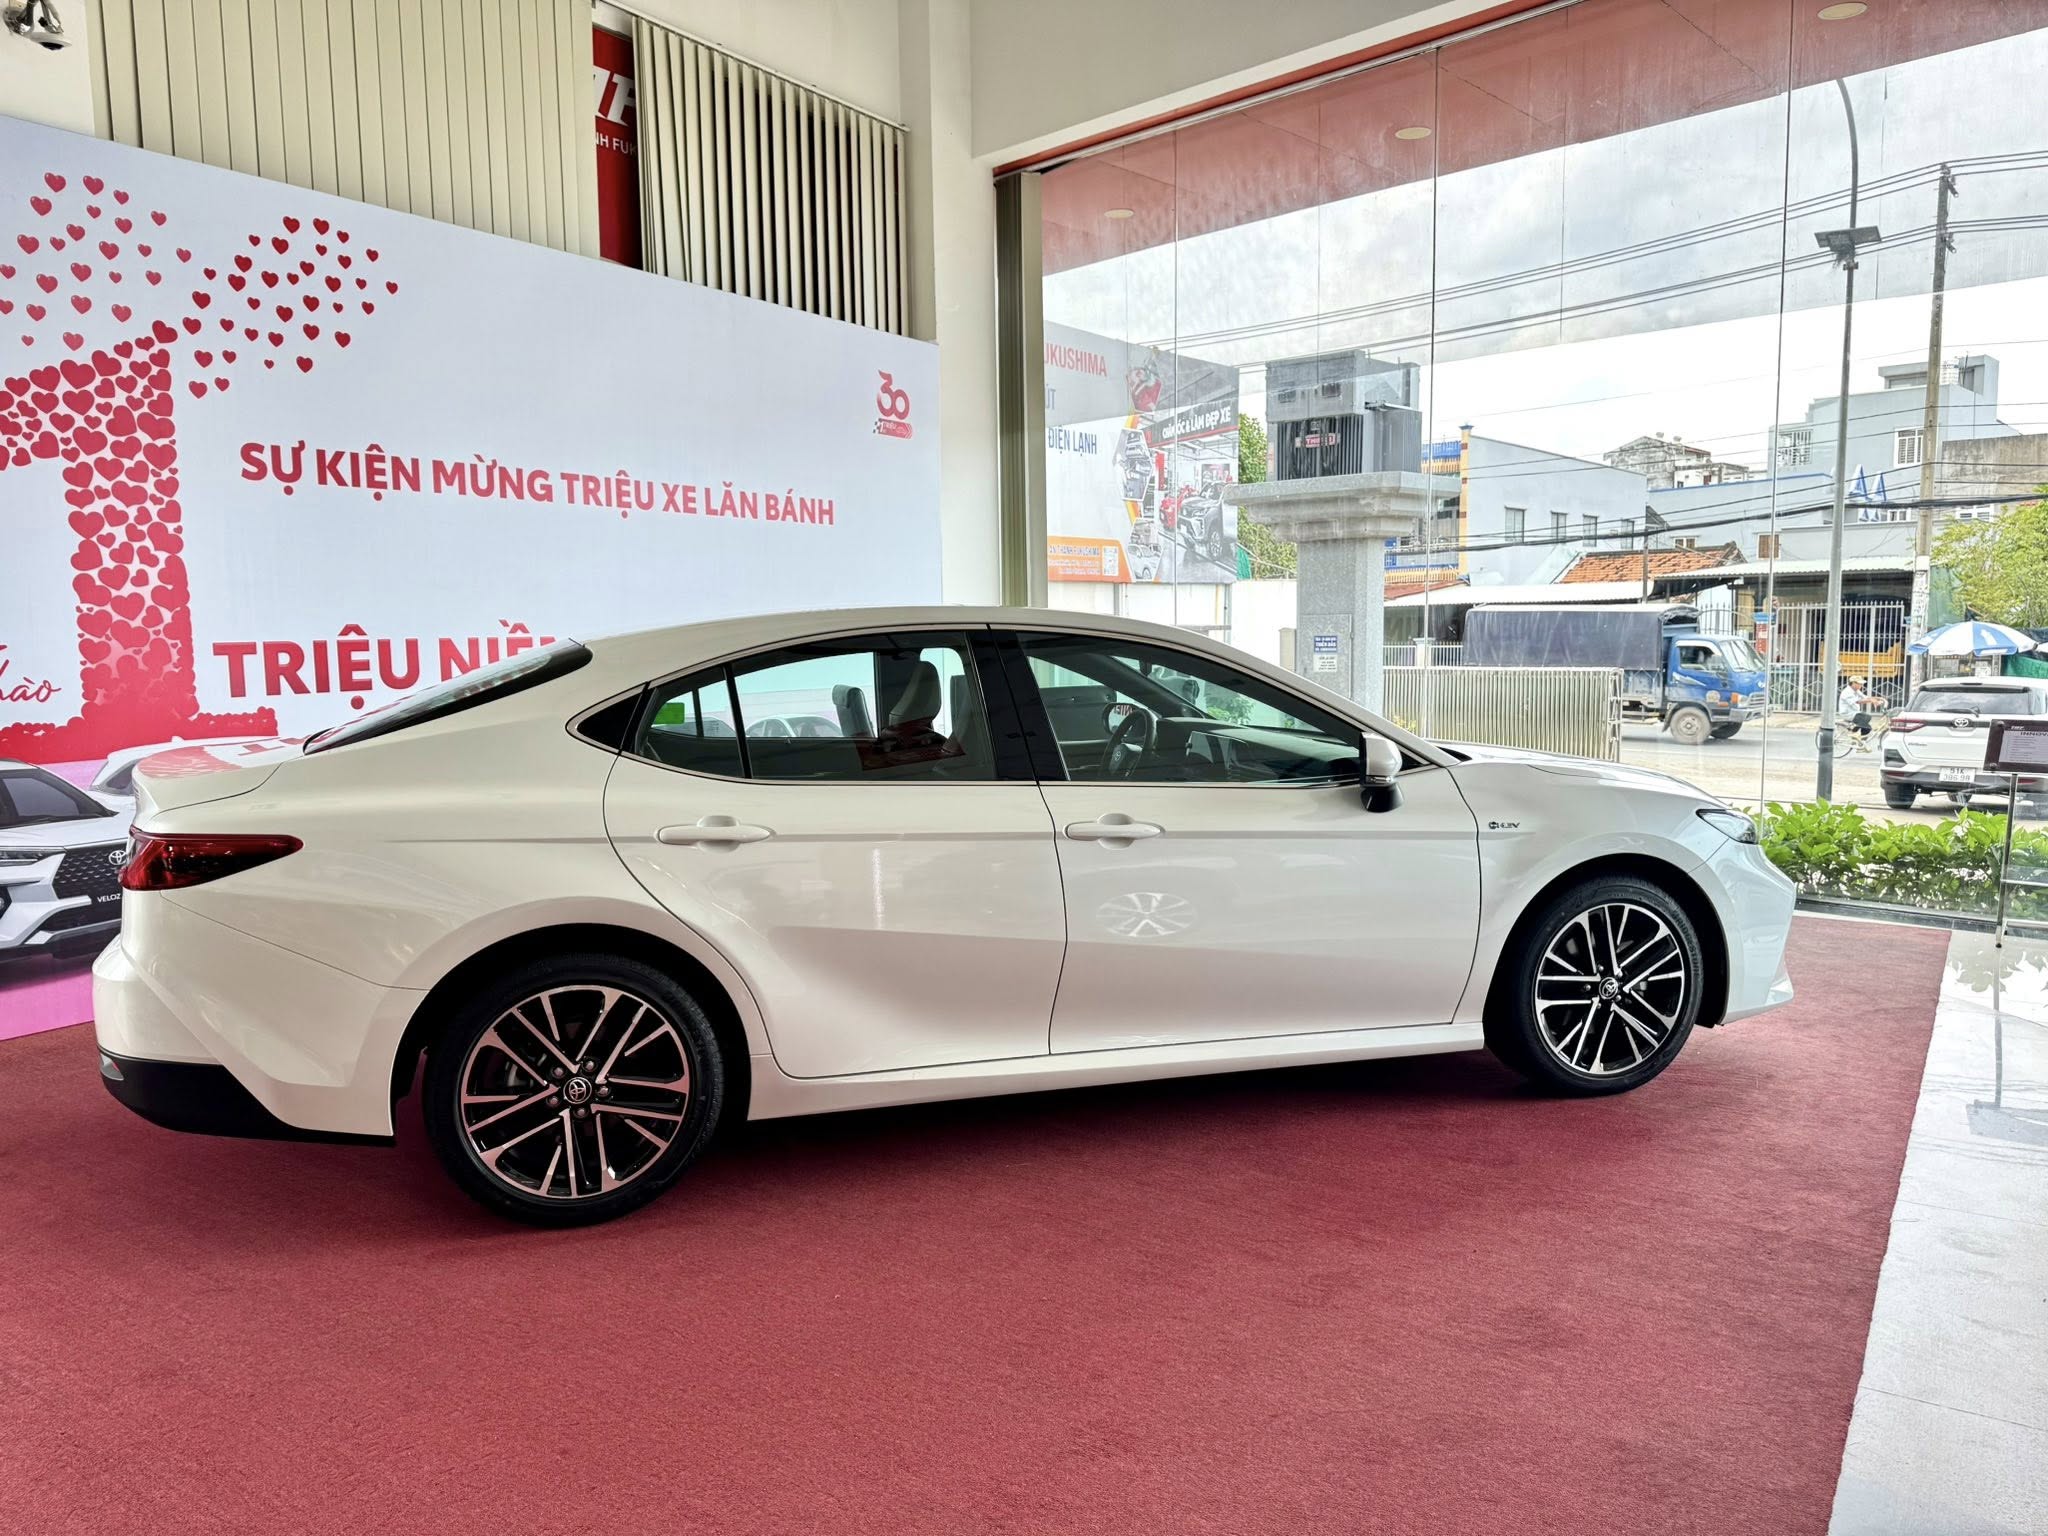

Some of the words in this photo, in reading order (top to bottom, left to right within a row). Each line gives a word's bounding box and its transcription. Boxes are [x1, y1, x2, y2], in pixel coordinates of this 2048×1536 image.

[877, 369, 910, 420] 30
[1073, 429, 1097, 457] LẠNH
[240, 440, 306, 496] SỰ
[316, 443, 421, 501] KIỆN
[432, 454, 554, 503] MỪNG
[560, 469, 655, 519] TRIỆU
[661, 483, 698, 515] XE
[704, 481, 759, 520] LĂN
[765, 488, 835, 525] BÁNH
[212, 623, 420, 710] TRIỆU
[97, 893, 121, 903] VELOZ
